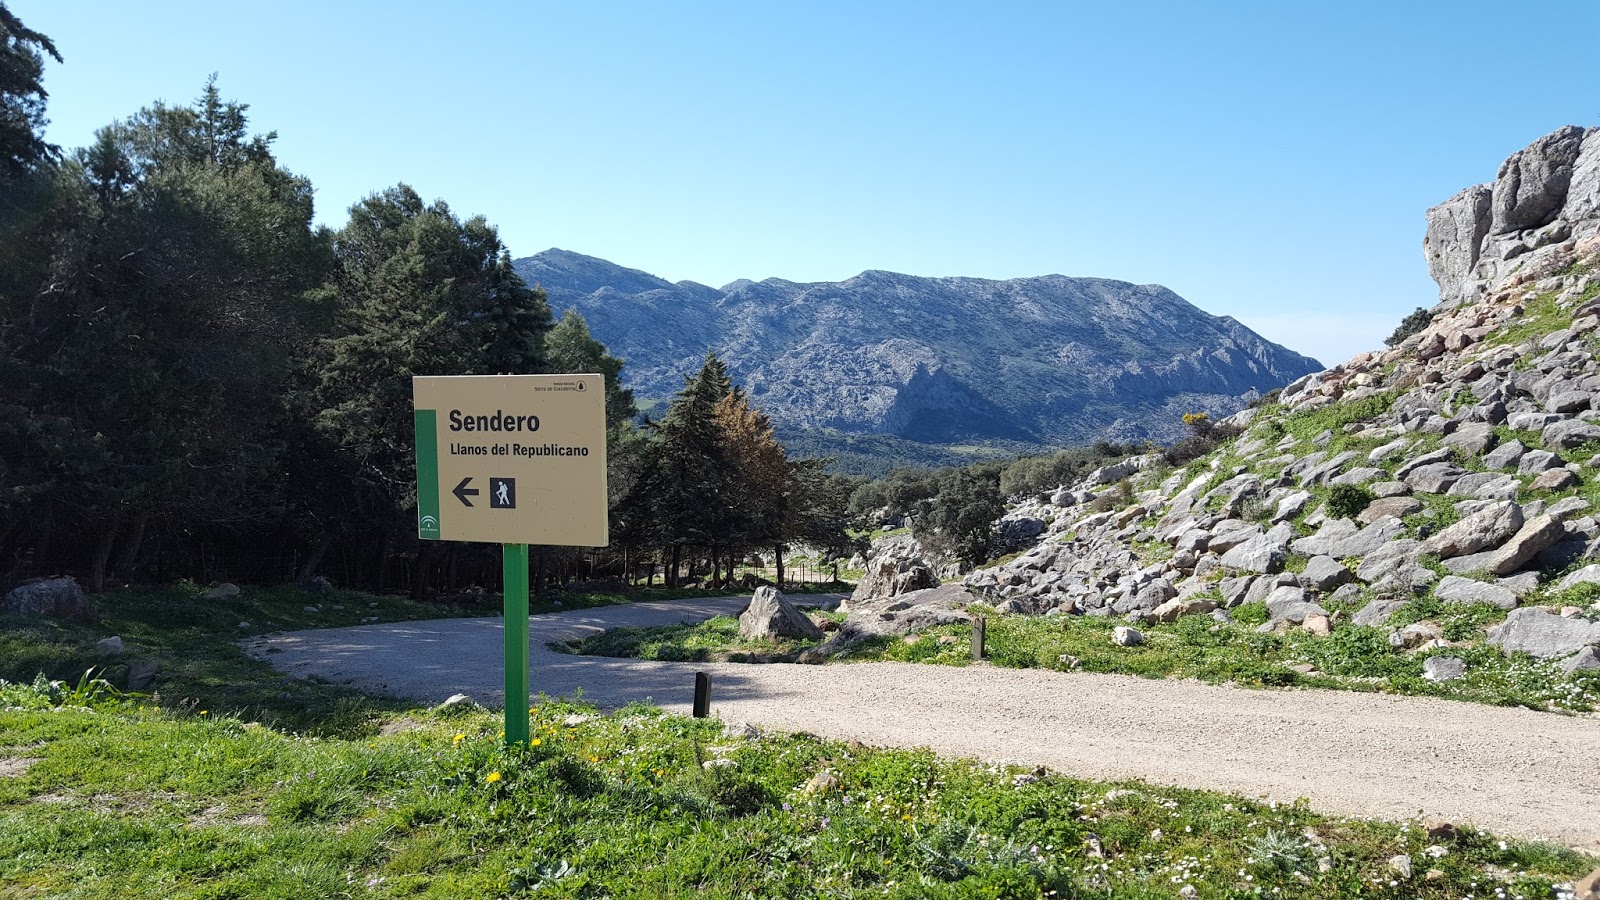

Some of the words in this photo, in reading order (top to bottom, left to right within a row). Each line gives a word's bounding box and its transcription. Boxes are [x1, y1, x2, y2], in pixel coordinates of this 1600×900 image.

[449, 409, 540, 432] Sendero
[450, 443, 488, 456] Llanos
[491, 443, 509, 456] del
[513, 443, 589, 458] Republicano
